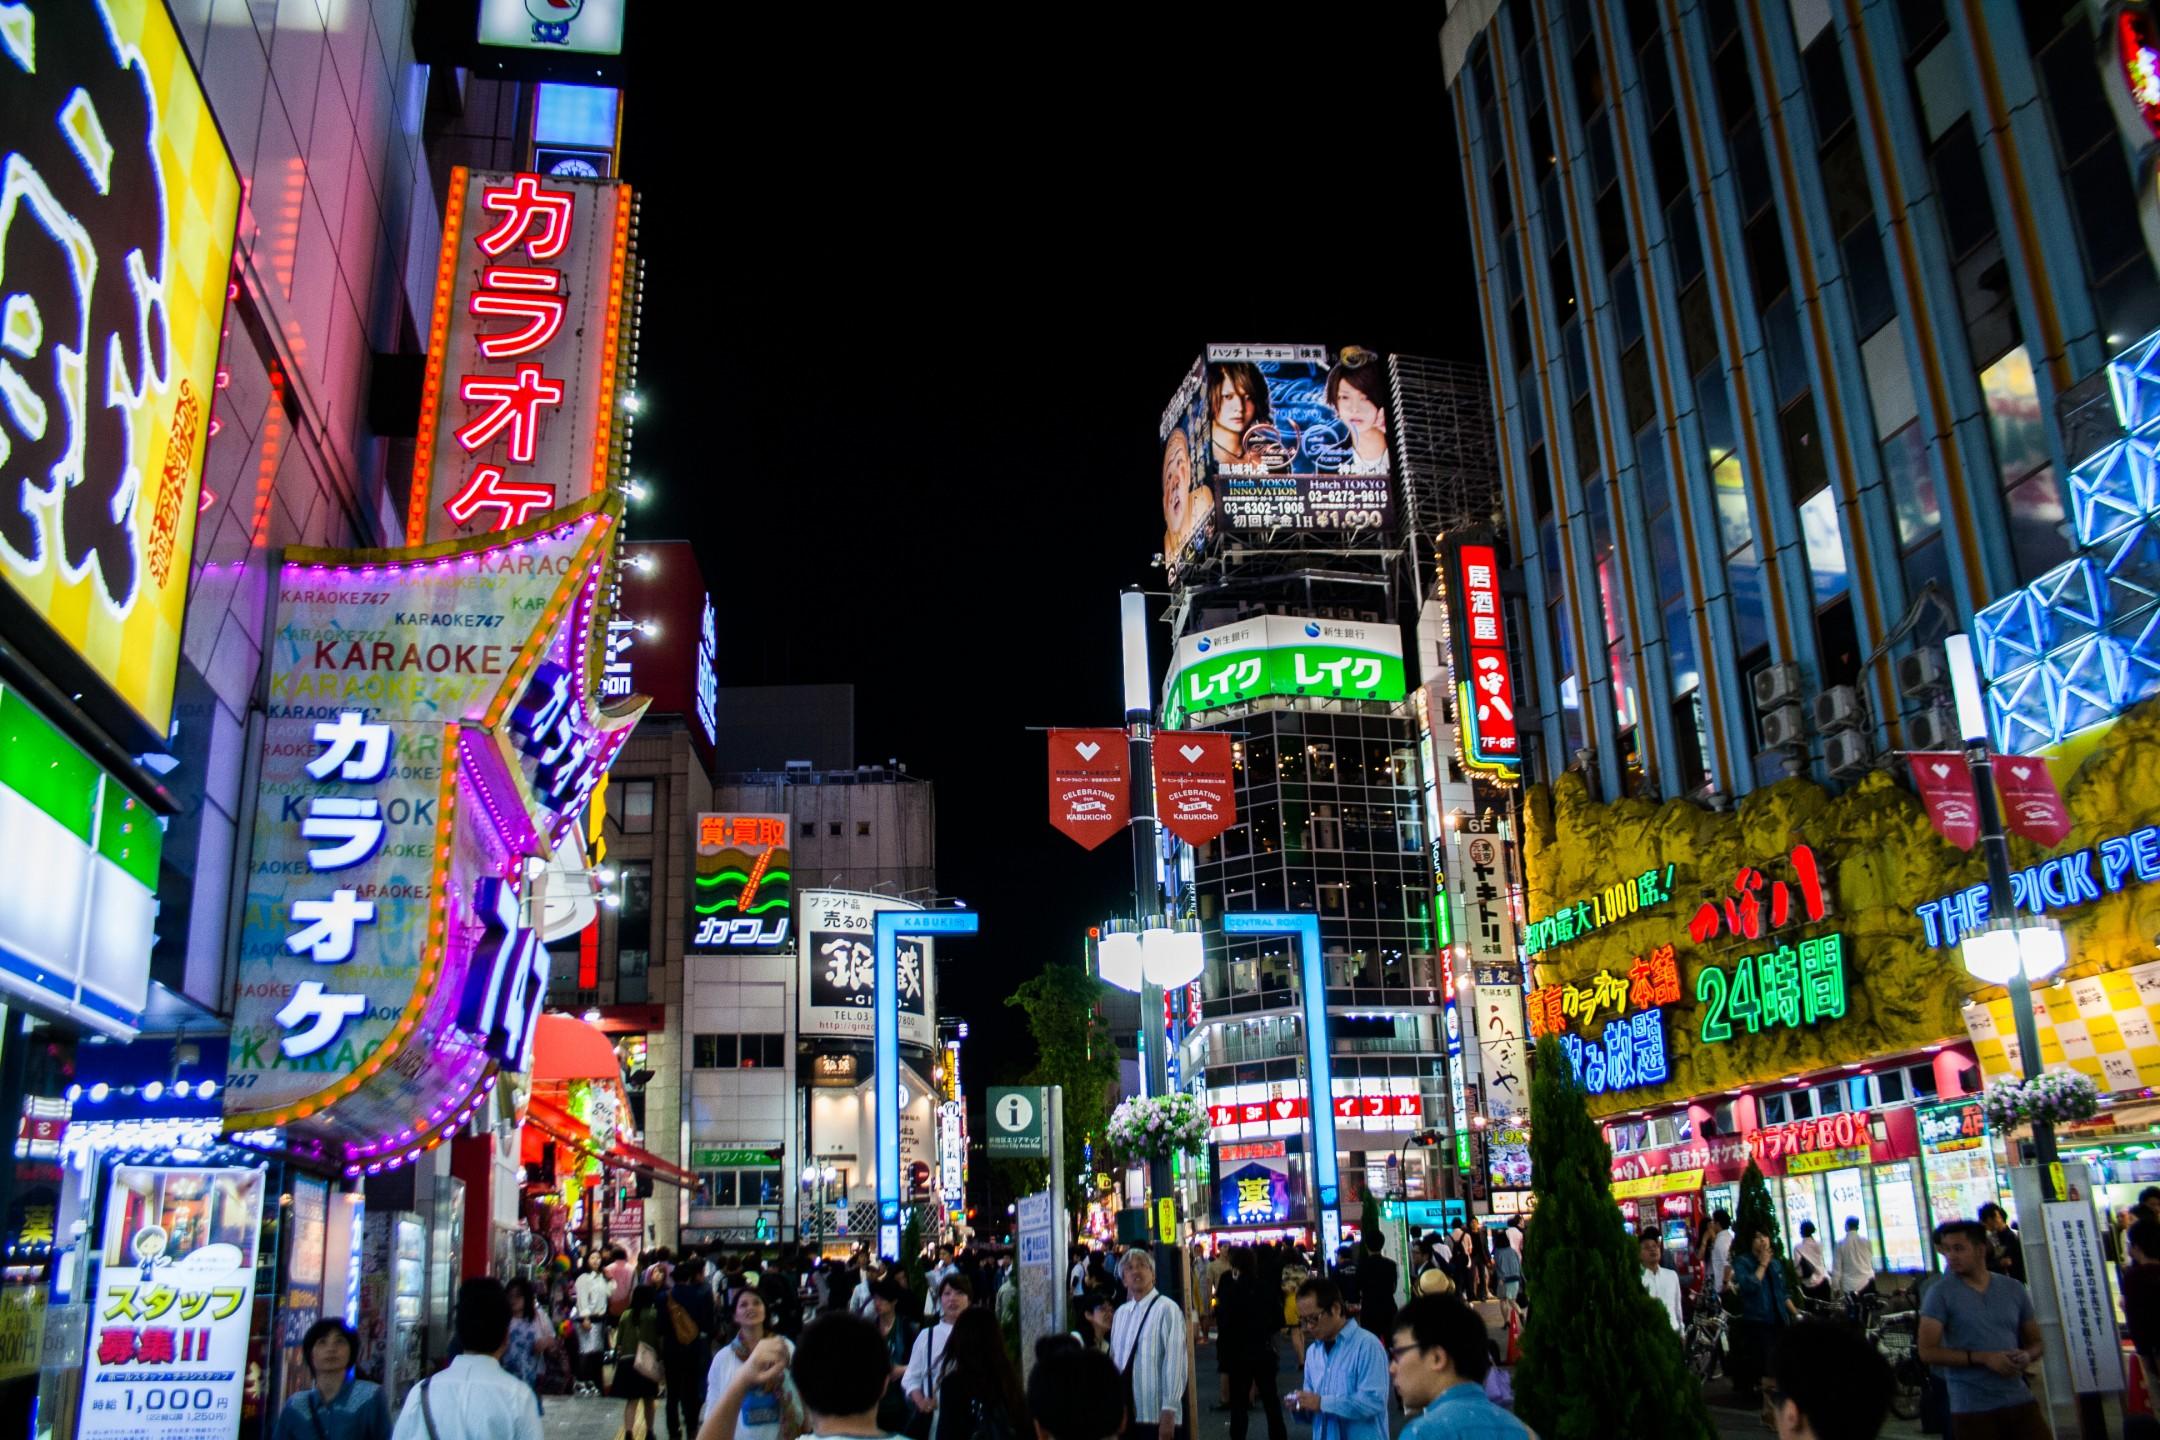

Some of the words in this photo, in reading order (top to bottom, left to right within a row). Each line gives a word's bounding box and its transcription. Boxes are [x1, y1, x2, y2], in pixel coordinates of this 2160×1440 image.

[444, 174, 576, 531] カラオケ
[1300, 347, 1321, 359] 検索
[1229, 479, 1254, 487] Hatch
[1260, 479, 1297, 487] TOKYO
[1309, 480, 1340, 489] Hatch
[1342, 480, 1385, 489] TOKYO
[1229, 488, 1297, 496] INNOVATION
[1308, 490, 1388, 502] 03-6273-9616
[280, 590, 390, 605] KARAOKE747
[1468, 564, 1498, 641] 居酒屋
[395, 612, 504, 628] KARAOKE747
[1213, 631, 1250, 647] 新生銀行
[1323, 626, 1365, 639] 新生銀行
[1190, 657, 1262, 701] レイク
[1294, 653, 1382, 689] レイク
[1477, 656, 1514, 721] つぼ八
[1062, 788, 1116, 801] CELEBRATING
[1168, 788, 1221, 802] CELEBRATING
[1080, 802, 1096, 810] NEW
[1187, 802, 1202, 810] NEW
[1066, 813, 1112, 821] KABUKICHO
[1173, 813, 1219, 821] KABUKICHO
[1468, 819, 1491, 833] 6F
[275, 712, 396, 1058] カラオケ
[810, 897, 861, 910] ブランド品
[1472, 863, 1500, 943] ヤキトリ
[1915, 882, 1990, 948] THE
[2010, 849, 2100, 915] PICK
[824, 910, 875, 929] 売るの
[1228, 918, 1274, 928] CENTRAL
[694, 916, 790, 945] カワノ
[1696, 933, 1846, 1043] 24時間
[1488, 1004, 1519, 1094] うさぎや
[1246, 1106, 1263, 1120] 3F
[1962, 1114, 1985, 1136] 4F
[1748, 1111, 1872, 1160] カラオケBOX
[103, 1283, 247, 1322] スタッフ
[97, 1325, 212, 1366] 募集!!
[92, 1400, 118, 1411] 時給
[125, 1388, 214, 1413] 1,000
[217, 1397, 229, 1410] 円
